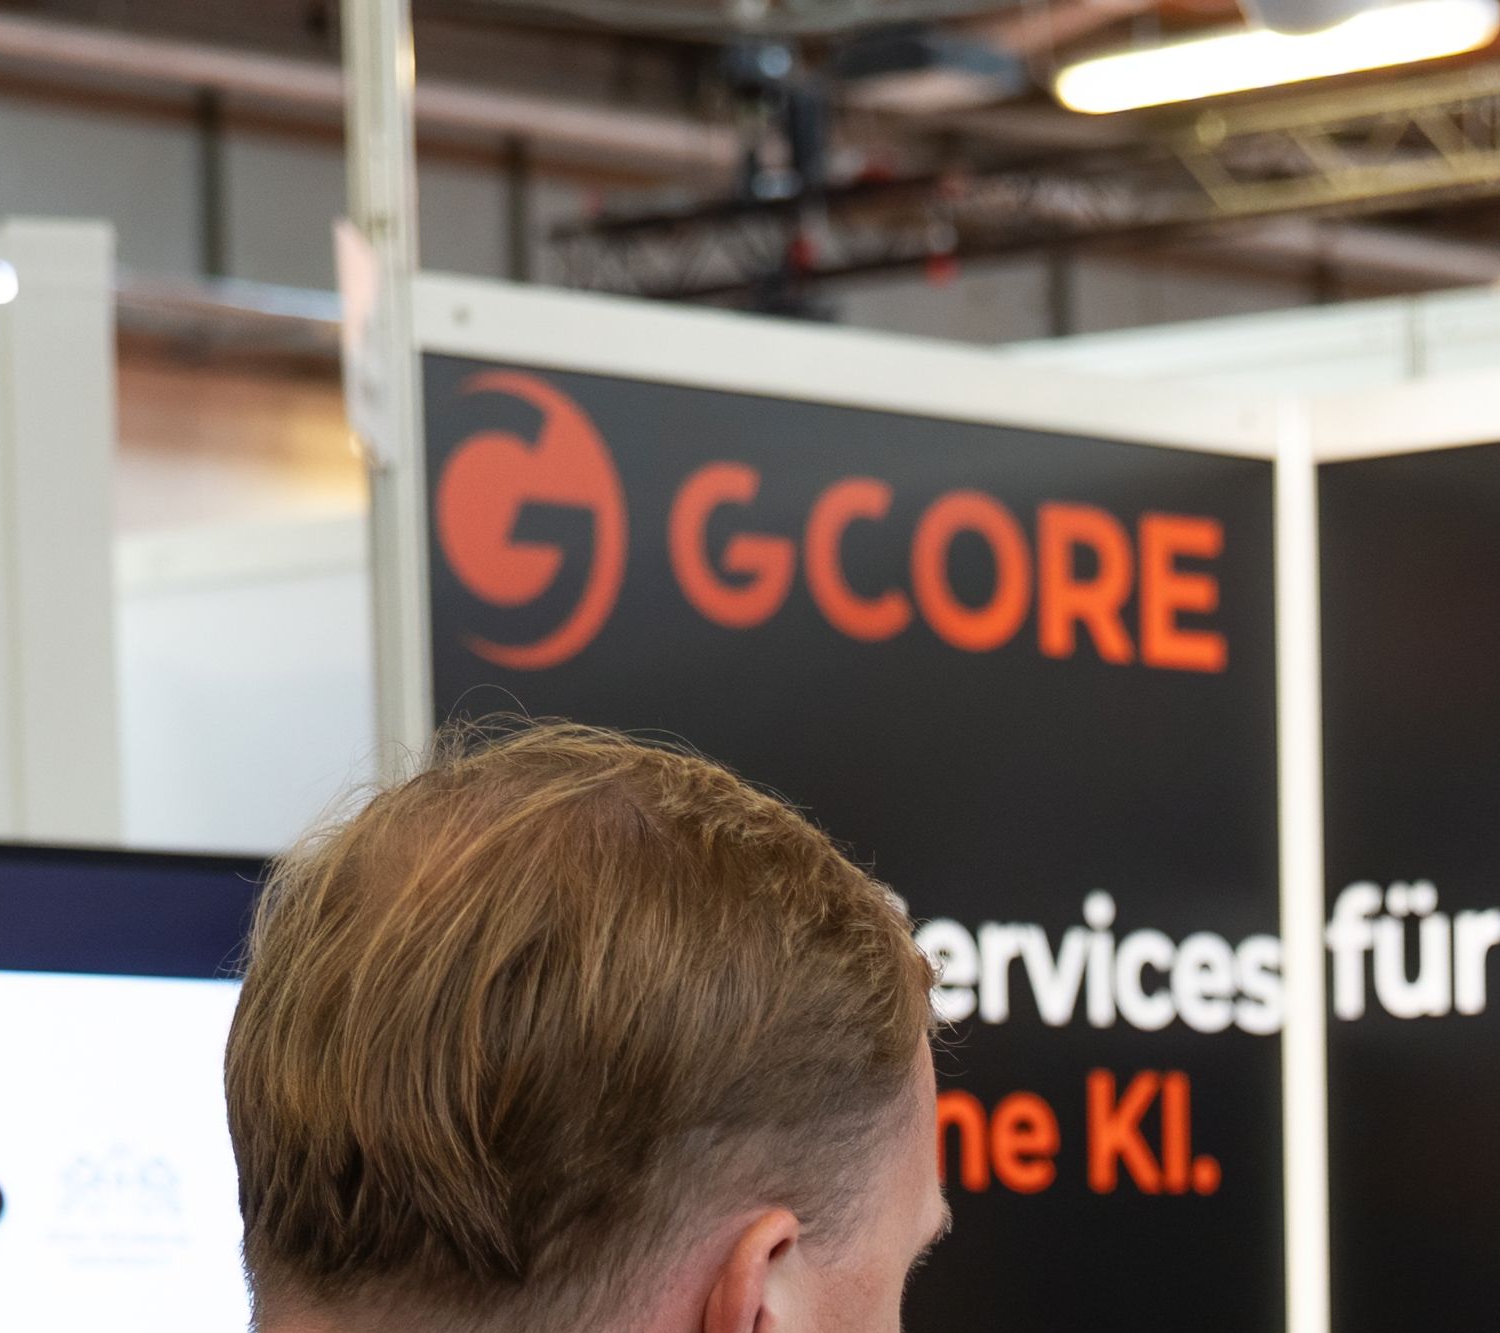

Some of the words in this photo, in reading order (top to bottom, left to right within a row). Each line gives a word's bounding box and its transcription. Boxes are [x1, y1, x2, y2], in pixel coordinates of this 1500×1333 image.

[668, 461, 1228, 672] GCORE
[900, 889, 1283, 1036] ervices
[936, 1089, 1061, 1194] ne
[1085, 1067, 1222, 1195] KI.
